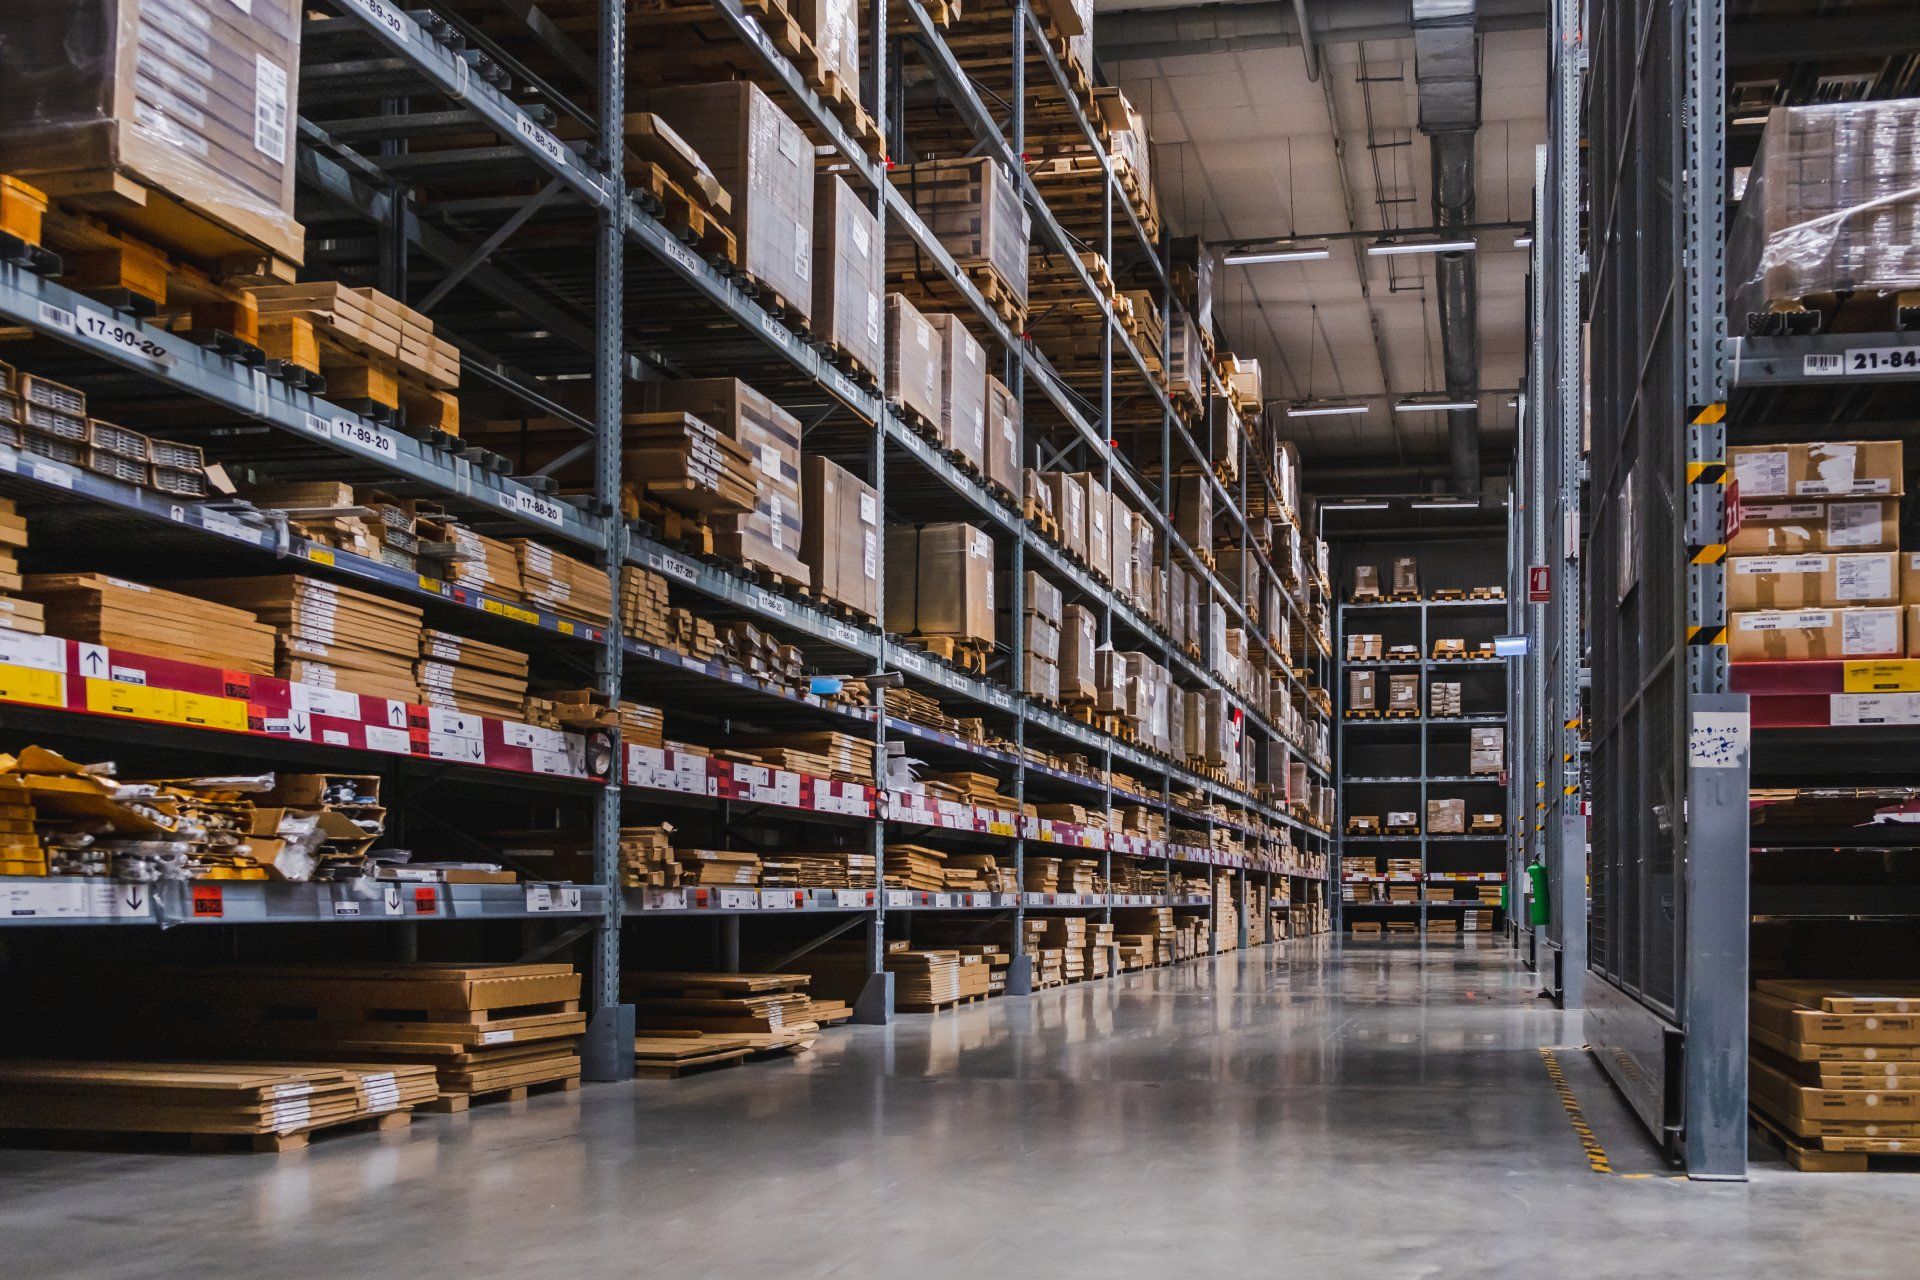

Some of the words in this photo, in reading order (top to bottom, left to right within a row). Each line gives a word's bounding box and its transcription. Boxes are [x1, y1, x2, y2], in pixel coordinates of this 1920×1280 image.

[361, 0, 400, 31] -89-30
[522, 121, 558, 157] 17-88-30
[87, 317, 166, 357] 17-90-20
[339, 421, 389, 450] 17-89-20
[522, 497, 558, 520] 17-88-20
[1726, 501, 1739, 536] 21
[667, 560, 694, 579] 17-87-20
